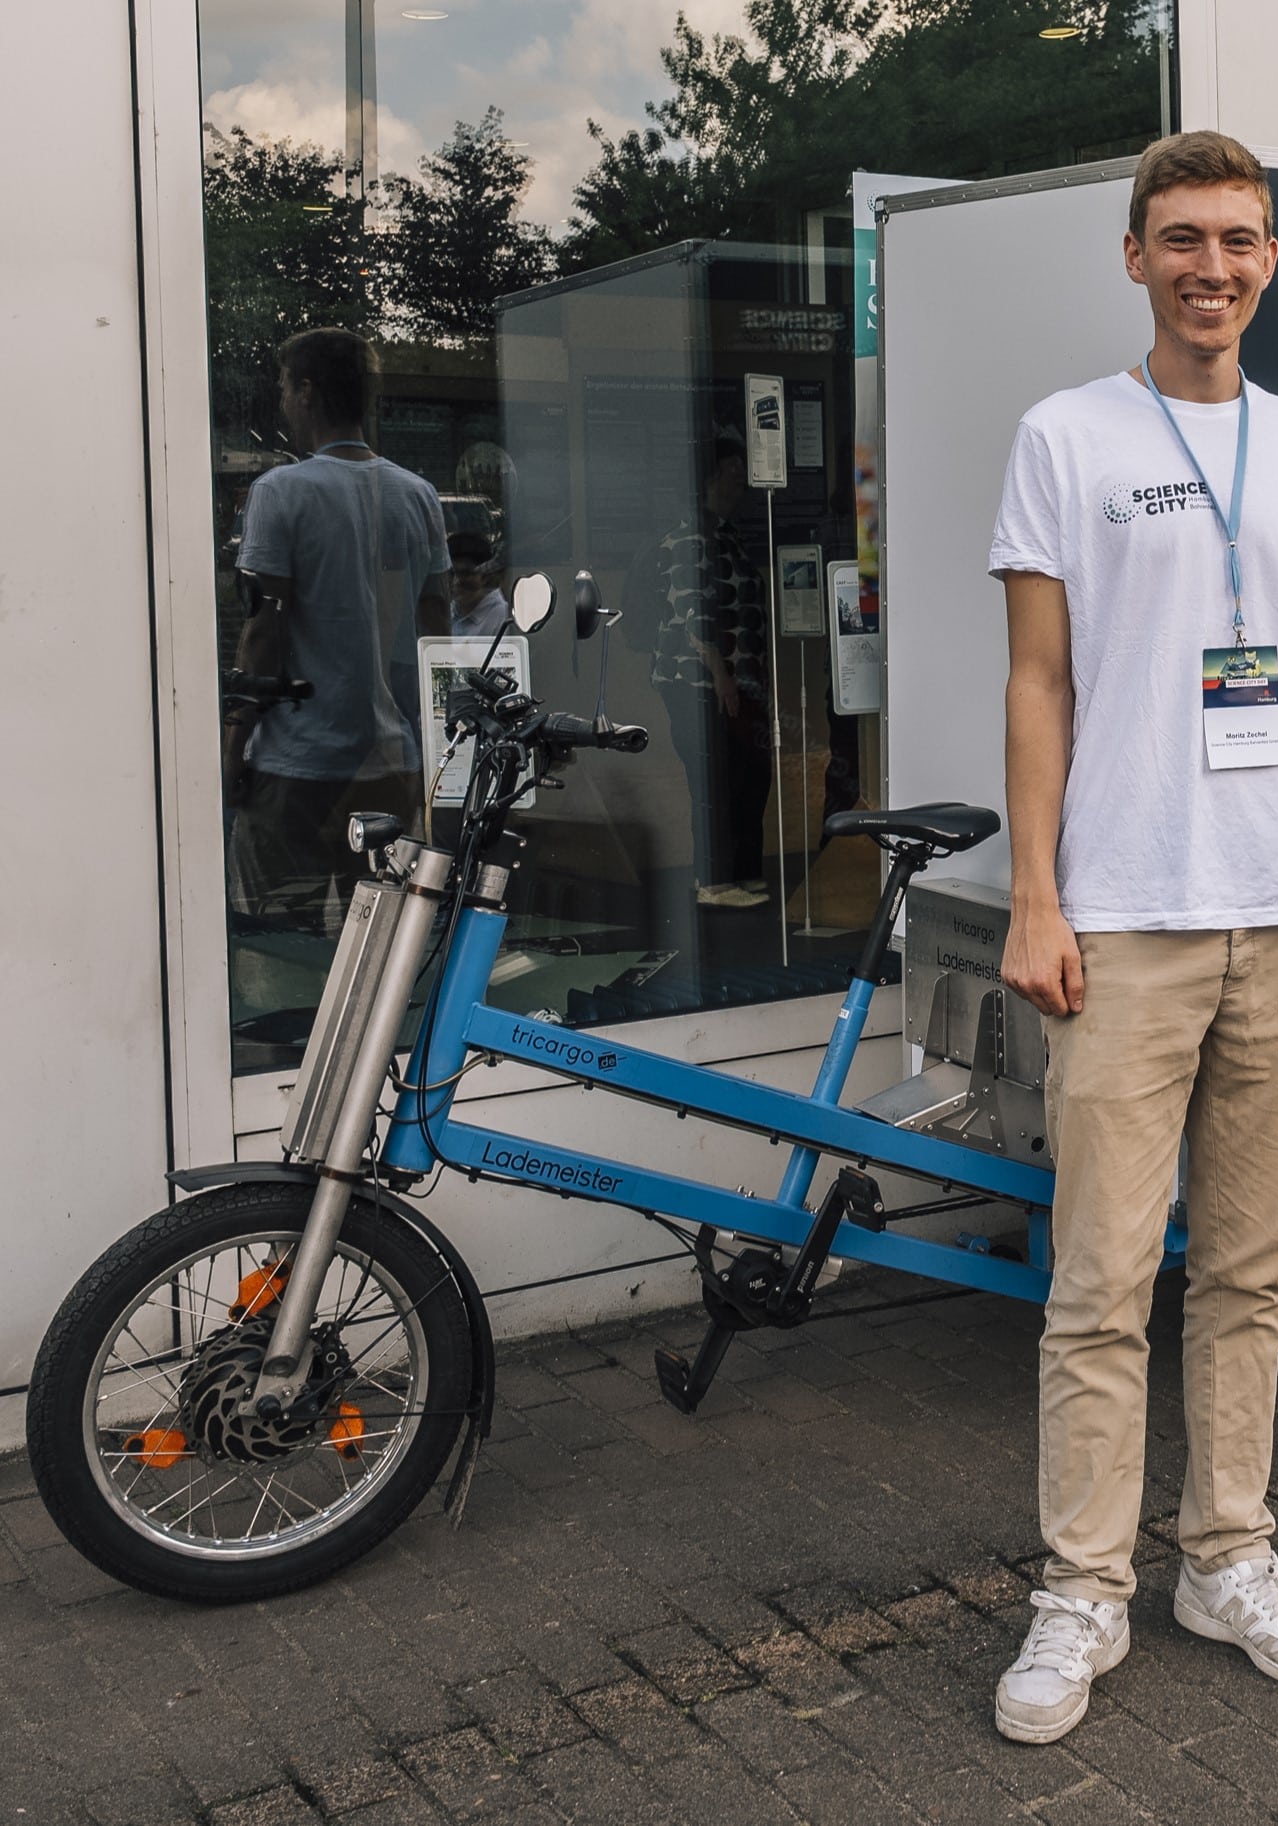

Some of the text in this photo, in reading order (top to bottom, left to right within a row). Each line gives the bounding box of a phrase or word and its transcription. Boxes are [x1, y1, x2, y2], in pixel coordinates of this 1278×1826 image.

[1132, 481, 1208, 502] SCIENCE
[1146, 497, 1187, 515] CITY
[953, 916, 995, 945] tricargo
[937, 945, 1002, 983] Lademeiste
[511, 1024, 594, 1066] tricargo
[482, 1141, 623, 1193] Lademeister
[797, 1260, 815, 1293] pinion
